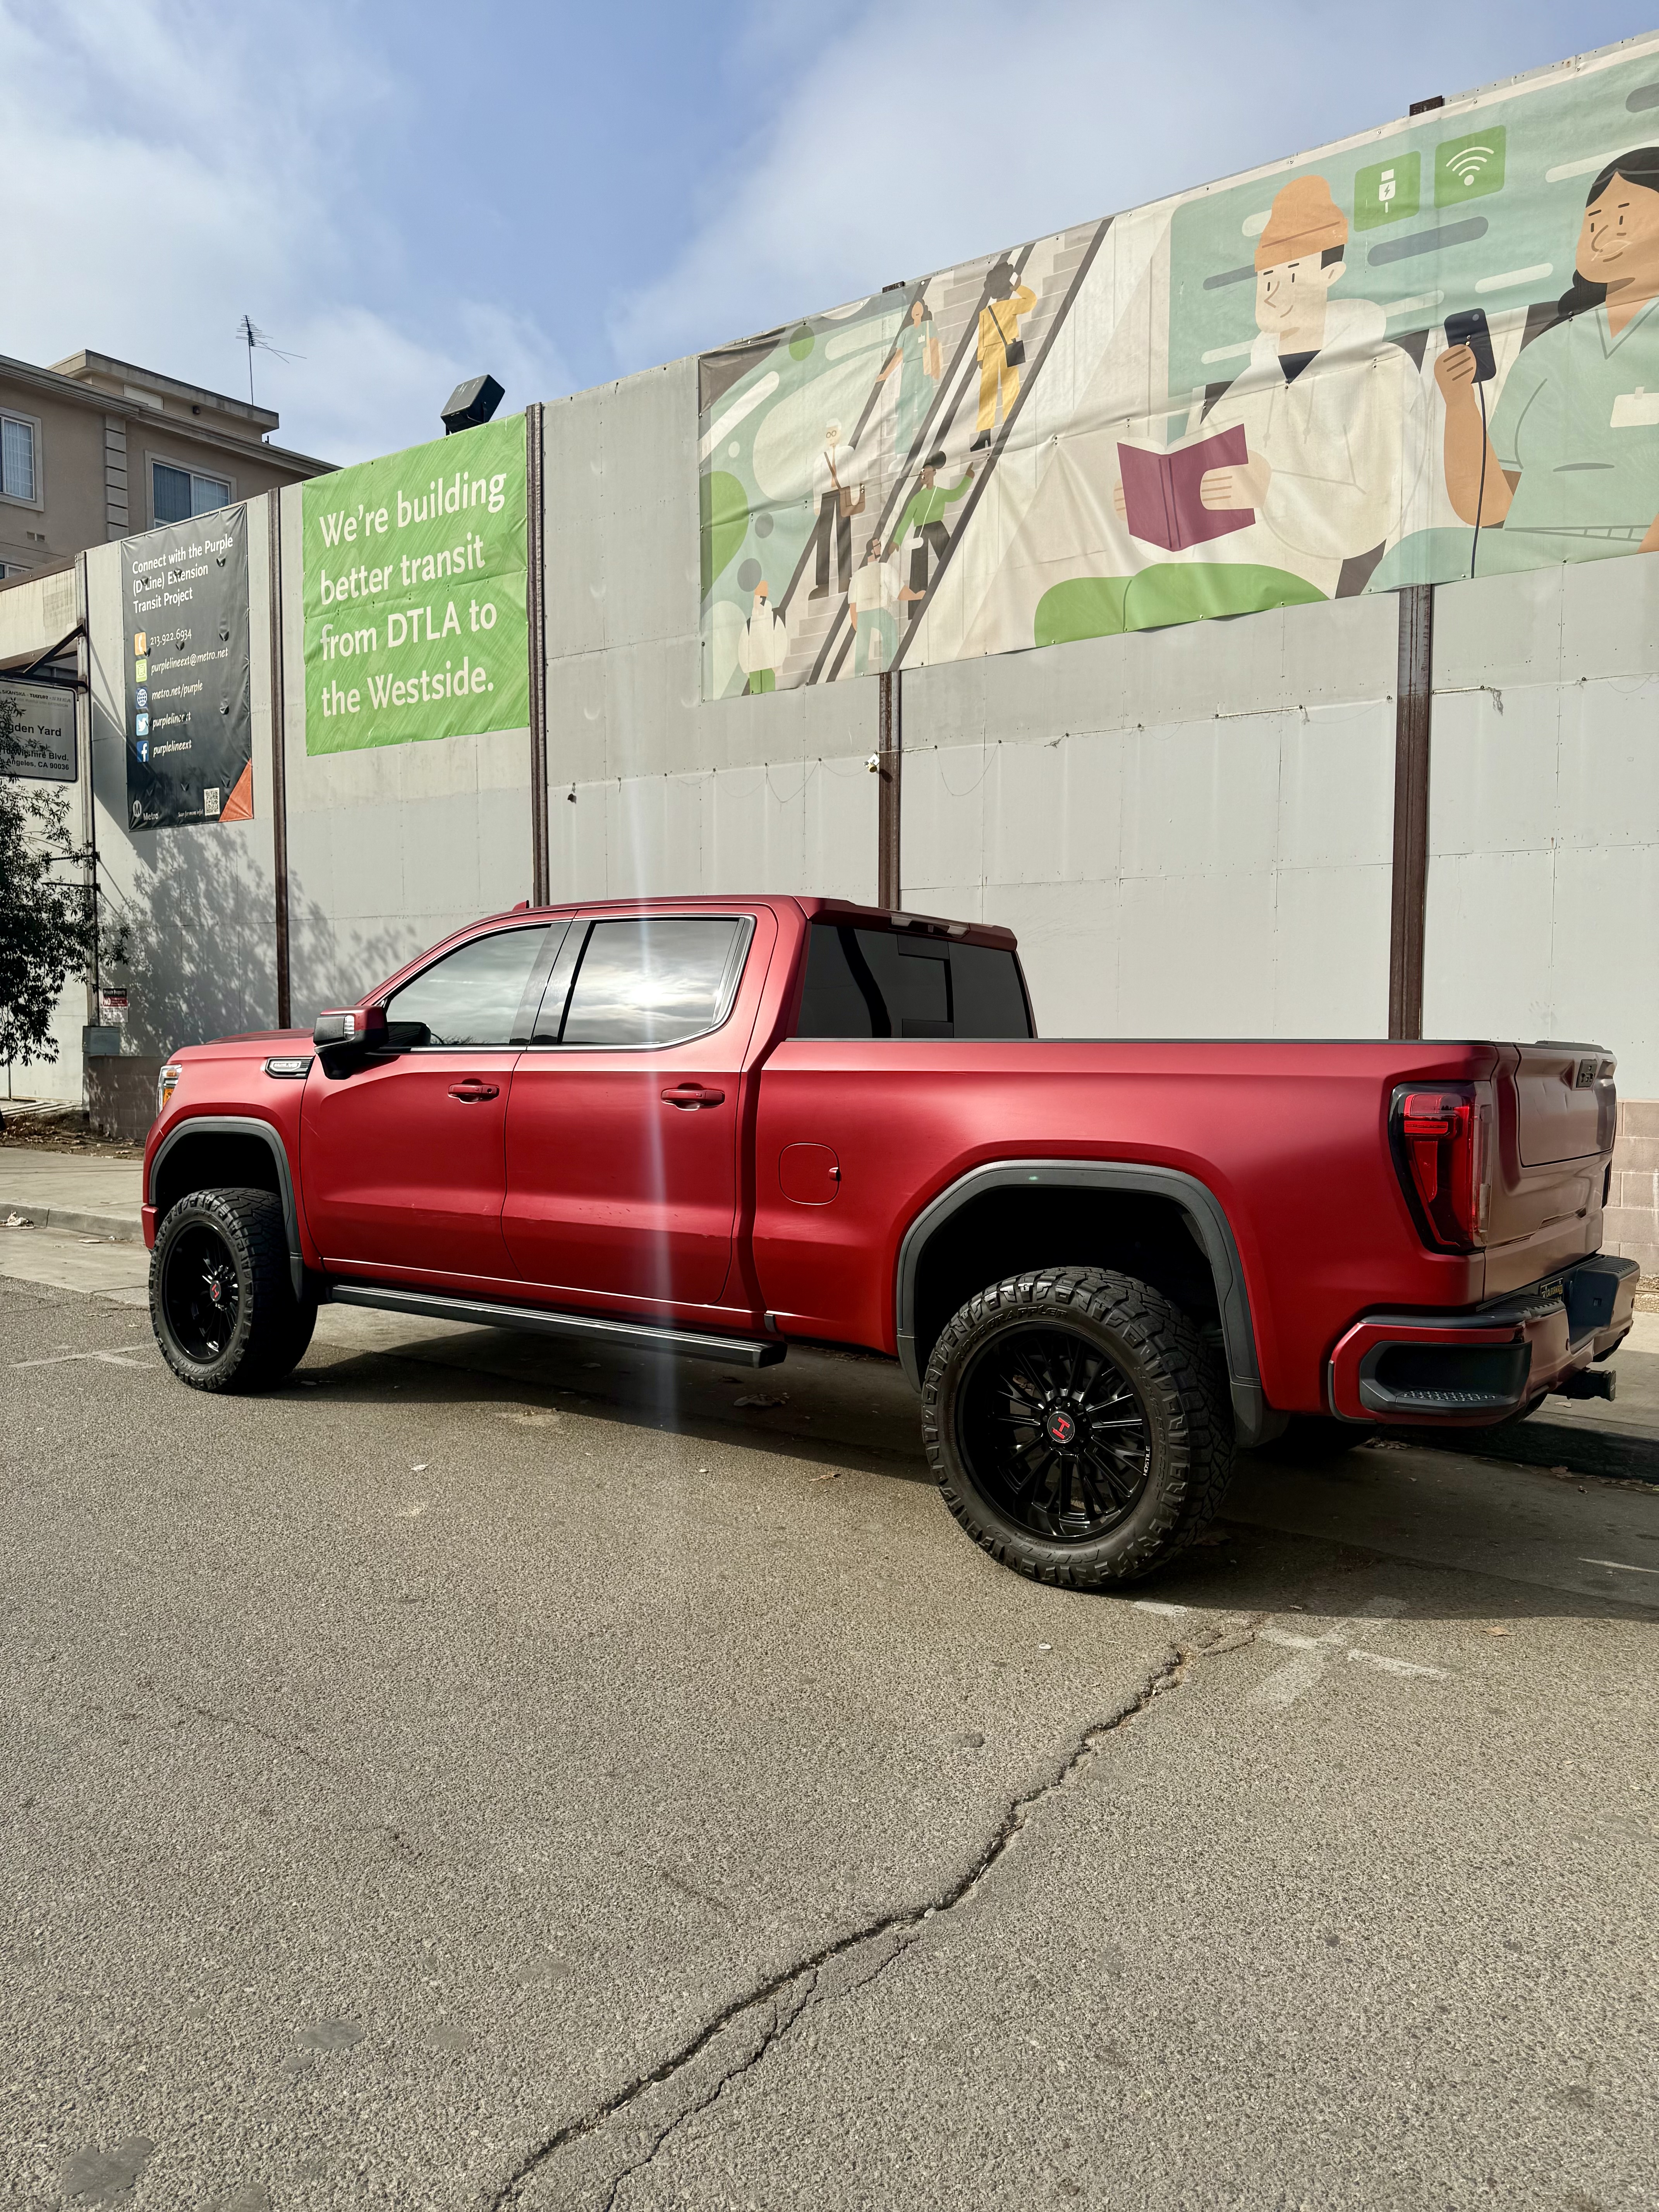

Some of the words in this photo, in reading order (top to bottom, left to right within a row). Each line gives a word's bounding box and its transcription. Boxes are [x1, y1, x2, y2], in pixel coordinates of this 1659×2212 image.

[319, 504, 388, 548] We're
[398, 471, 507, 527] building
[132, 554, 167, 574] Connect
[169, 546, 186, 564] with
[189, 543, 202, 558] the
[205, 534, 233, 554] Purple
[133, 579, 143, 597] (D
[168, 563, 208, 585] Extension
[321, 565, 393, 606] better
[400, 532, 486, 586] transit
[133, 594, 161, 613] Transit
[164, 587, 193, 607] Project
[150, 629, 192, 647] 213.922.6934
[320, 623, 377, 661] from
[388, 601, 461, 648] DTLA
[469, 599, 497, 632] to
[151, 647, 228, 676] purplelineext@metro.net
[152, 680, 203, 700] metro.net/purple
[322, 680, 361, 718] the
[367, 656, 494, 709] Westside.
[37, 725, 61, 737] Yard
[49, 752, 69, 761] Blvd.
[153, 739, 192, 758] purplelineext
[143, 812, 159, 821] Metro
[104, 997, 111, 1006] NO
[986, 1304, 1068, 1328] GRAPPLER
[1142, 1445, 1151, 1476] HOSTILE
